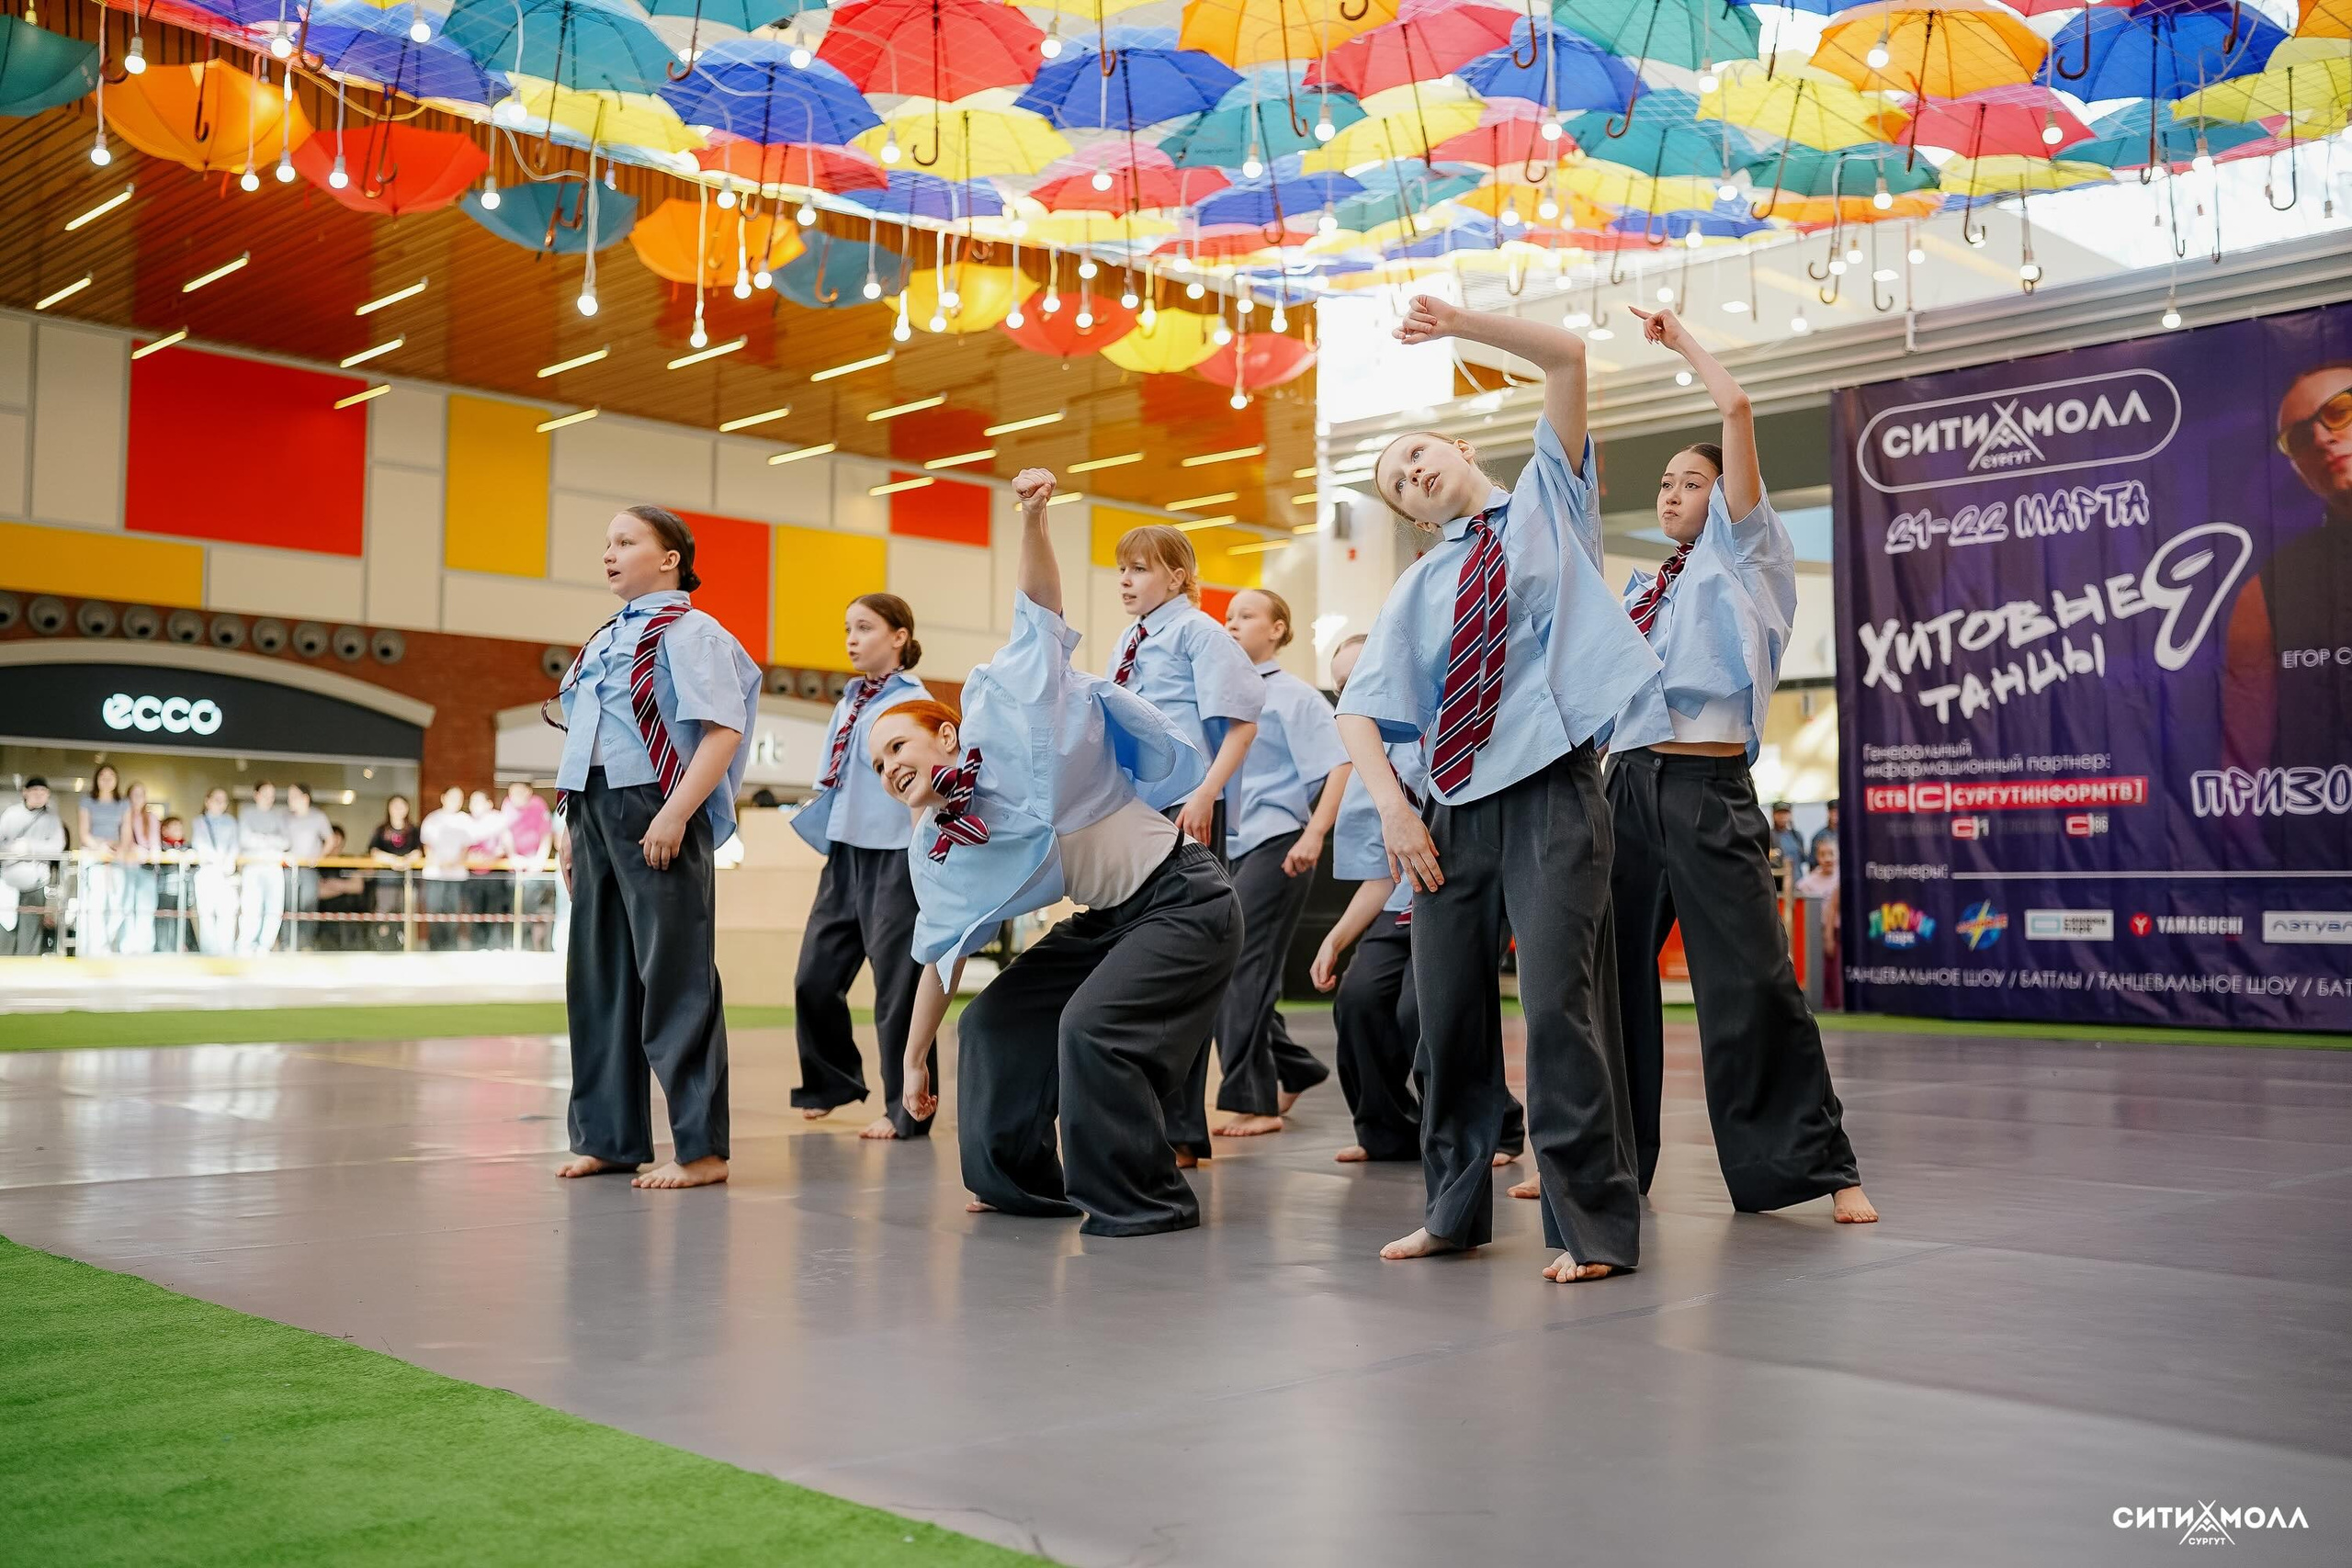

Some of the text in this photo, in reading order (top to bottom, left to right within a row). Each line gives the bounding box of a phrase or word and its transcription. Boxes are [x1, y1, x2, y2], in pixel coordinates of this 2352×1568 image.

[1884, 479, 2151, 555] 21-22 МАРТА
[1857, 572, 2145, 694] ХИТОВЫЕ
[1917, 632, 2106, 725] ТАНЦЫ
[2281, 648, 2331, 669] ЕГОР
[102, 693, 223, 736] ecco
[2190, 763, 2352, 818] ПРИЗО
[2155, 915, 2244, 935] YAMAGUCHI
[1962, 967, 2006, 988] ШОУ
[2098, 970, 2243, 995] ТАНЦЕВАЛЬНОЕ
[2245, 975, 2298, 996] ШОУ
